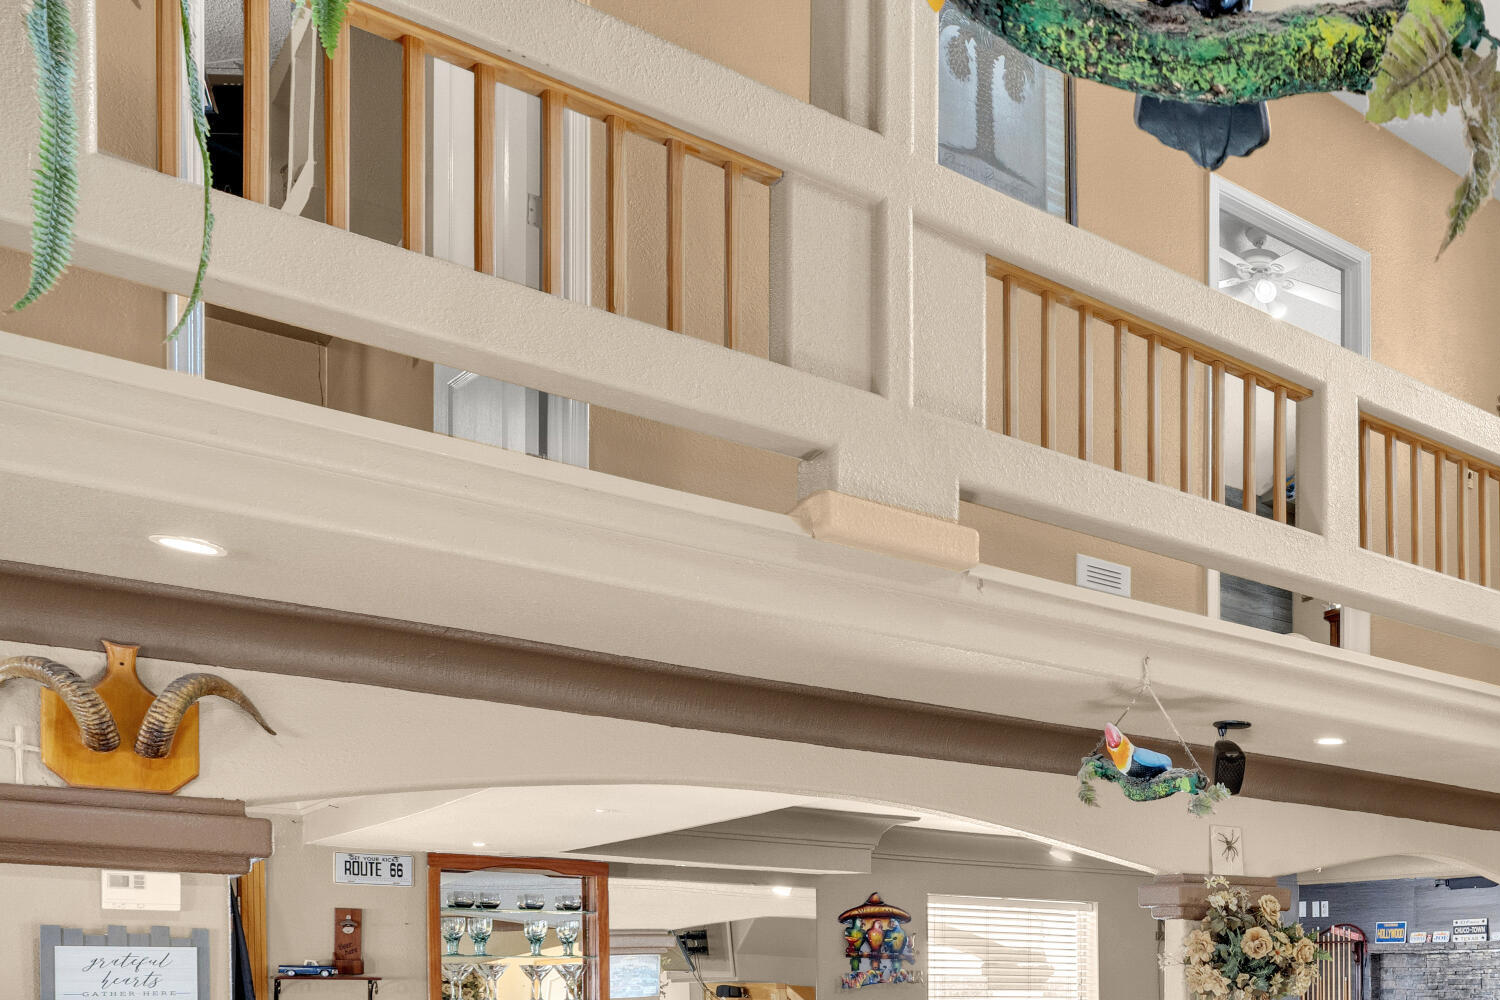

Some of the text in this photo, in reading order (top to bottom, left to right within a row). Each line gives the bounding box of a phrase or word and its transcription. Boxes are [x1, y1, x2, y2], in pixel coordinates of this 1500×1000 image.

[344, 860, 404, 878] ROUTE 66
[1454, 926, 1486, 934] CHUCO-TOWN
[82, 952, 173, 972] grateful
[102, 970, 165, 989] hearts
